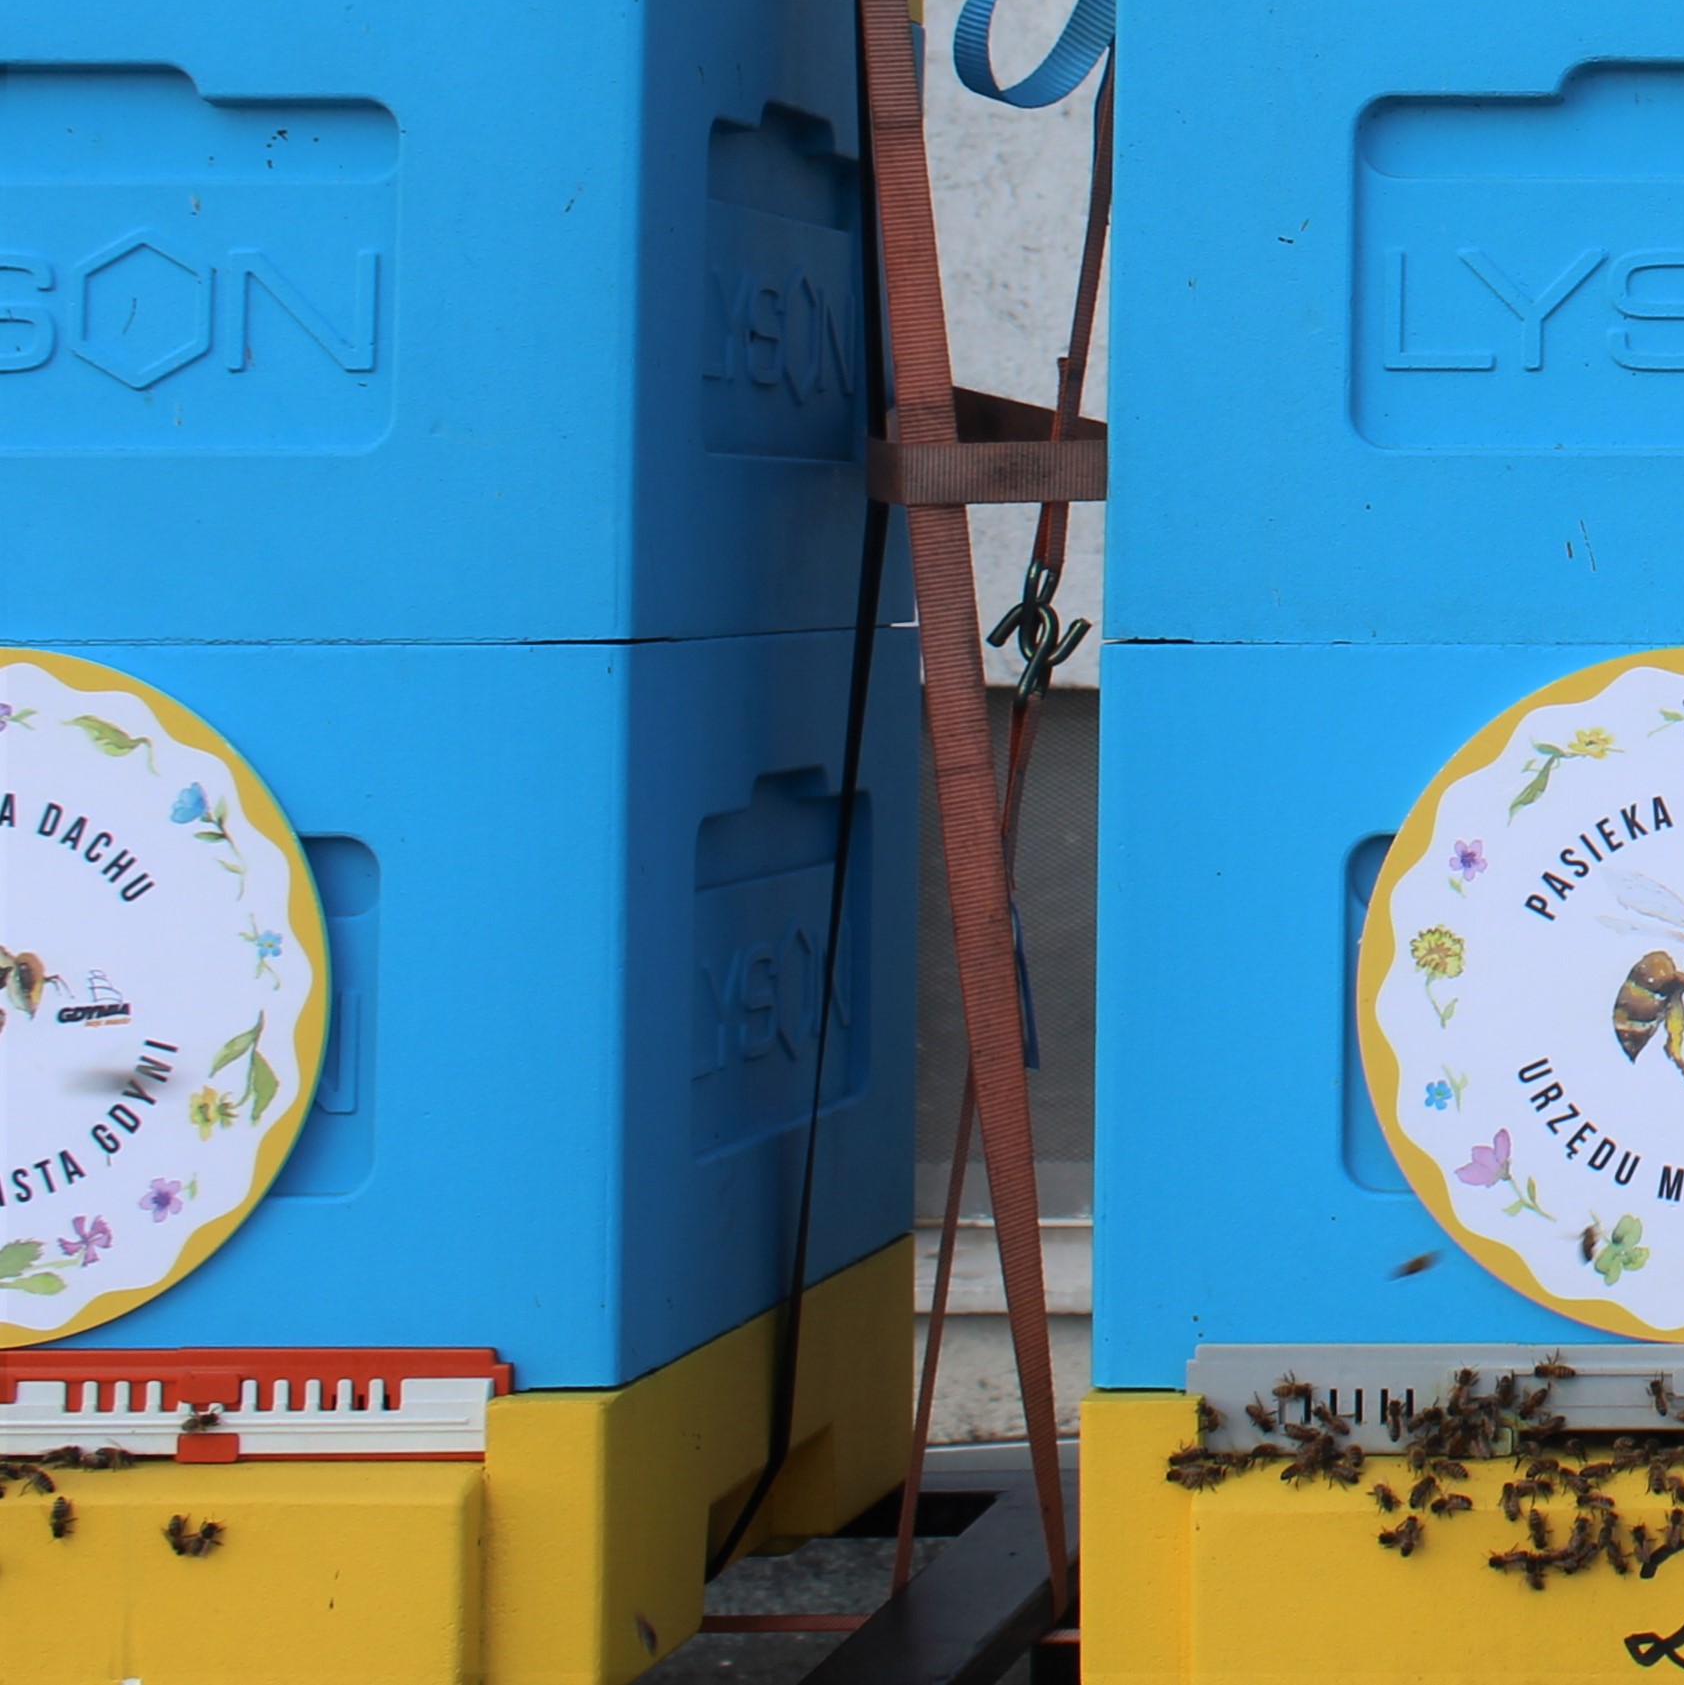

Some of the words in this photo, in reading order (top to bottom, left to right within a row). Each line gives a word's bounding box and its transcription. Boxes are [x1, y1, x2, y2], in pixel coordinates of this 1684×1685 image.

[38, 802, 155, 902] DACHU
[1524, 796, 1673, 921] PASIEKA
[91, 1039, 178, 1154] GDYNI
[1518, 1058, 1641, 1186] URZĘDU
